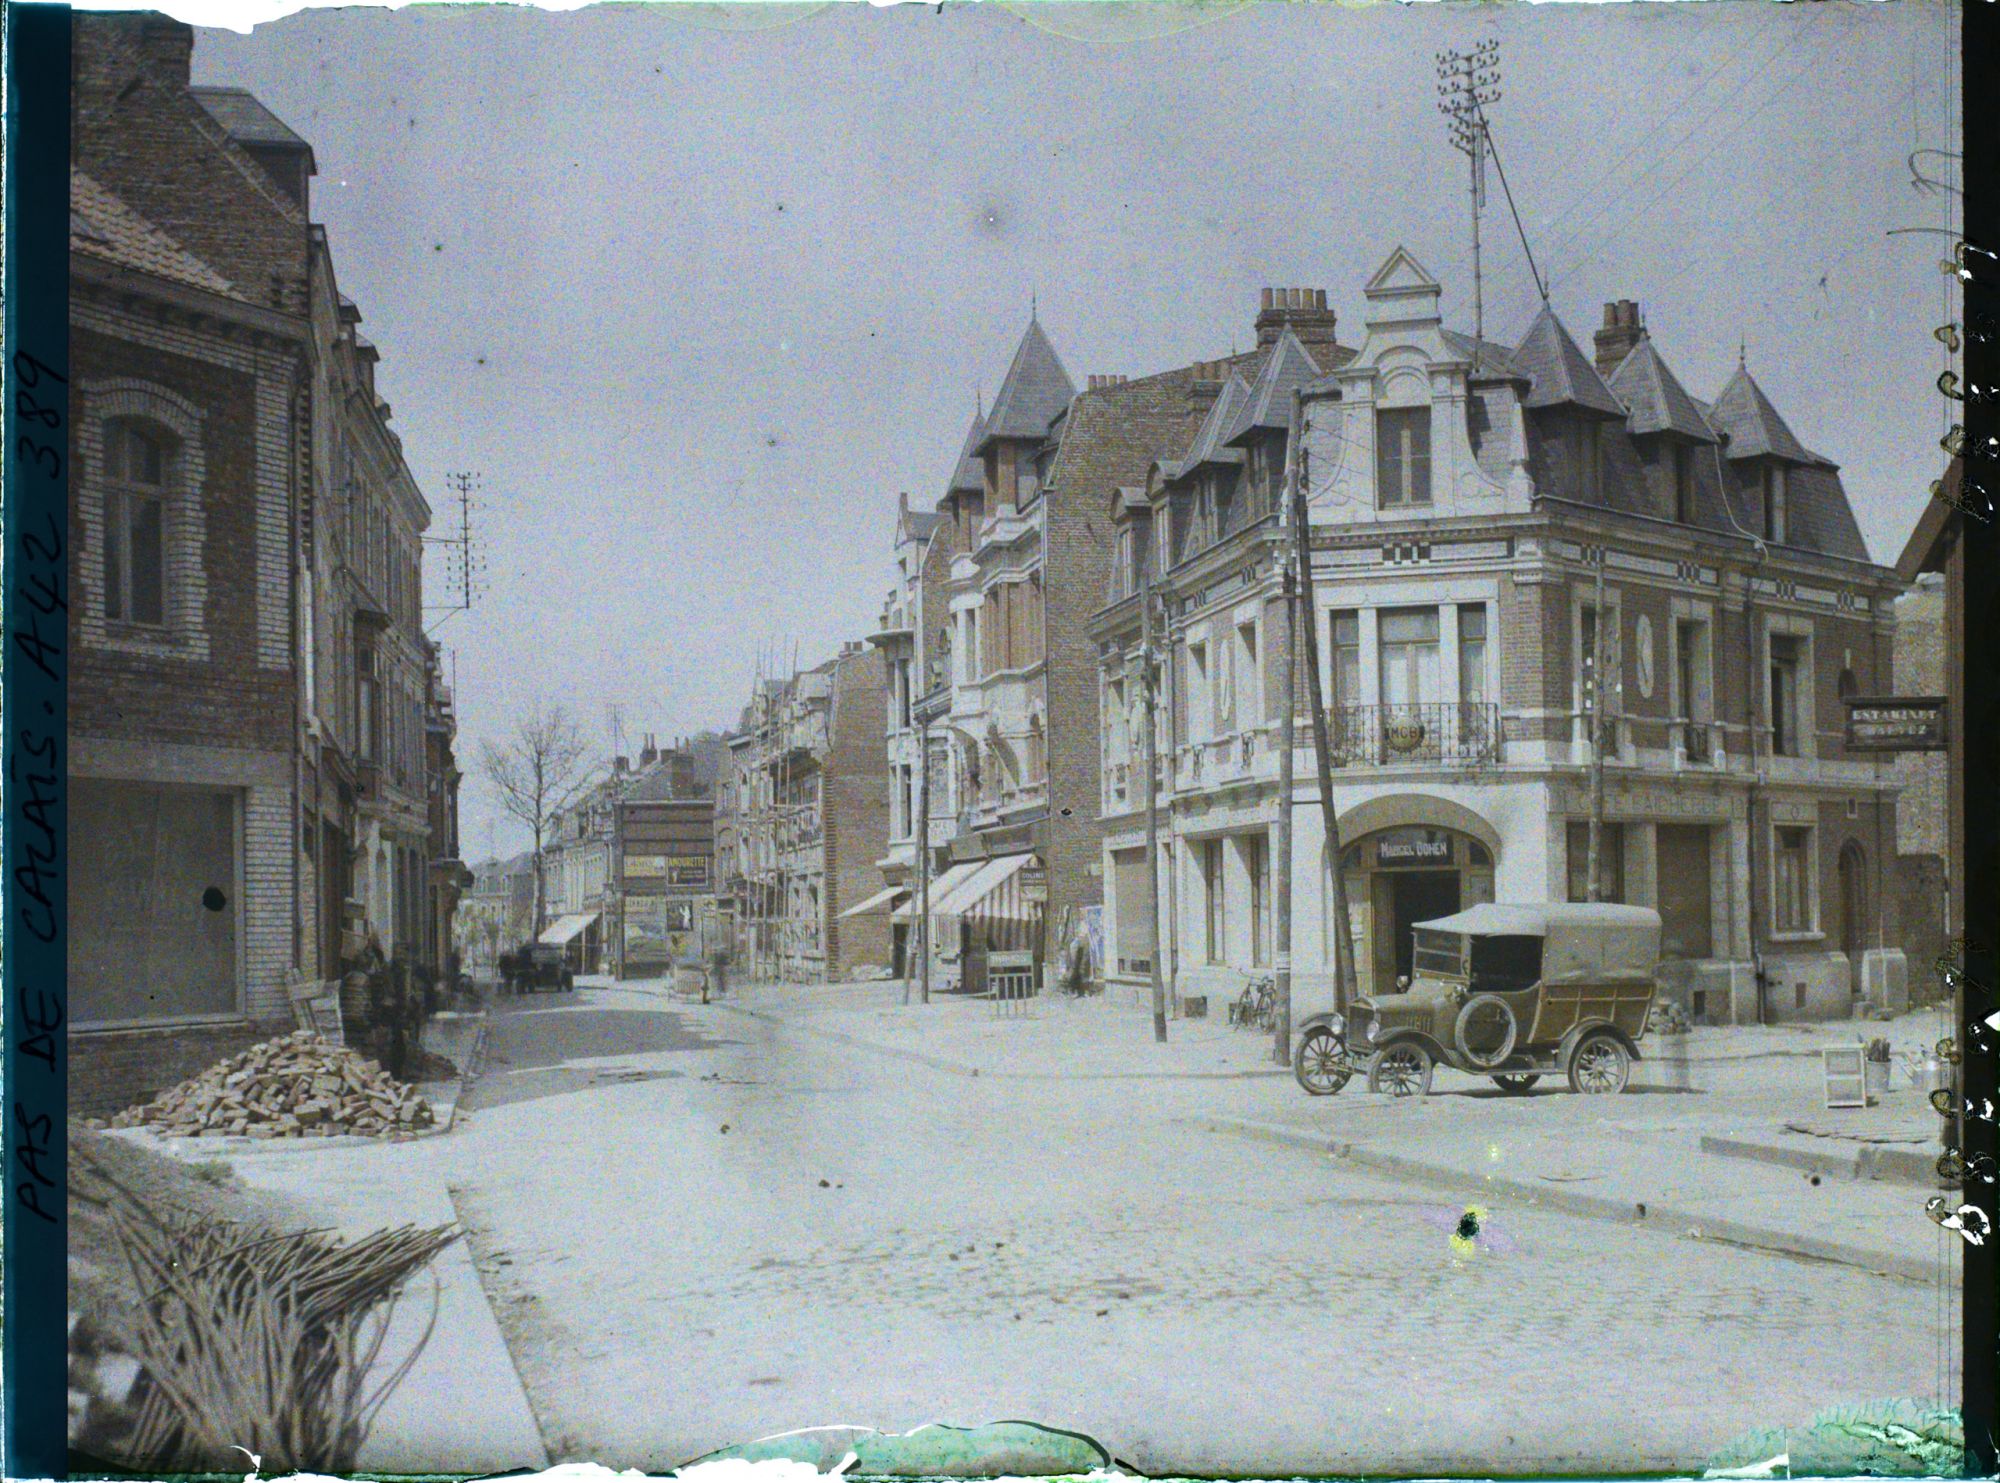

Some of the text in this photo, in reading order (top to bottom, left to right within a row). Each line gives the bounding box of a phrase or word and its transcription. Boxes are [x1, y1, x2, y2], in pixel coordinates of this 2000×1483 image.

[15, 350, 66, 482] 389
[1391, 726, 1418, 739] MCB
[19, 988, 62, 1073] DE
[15, 1103, 58, 1225] PAS
